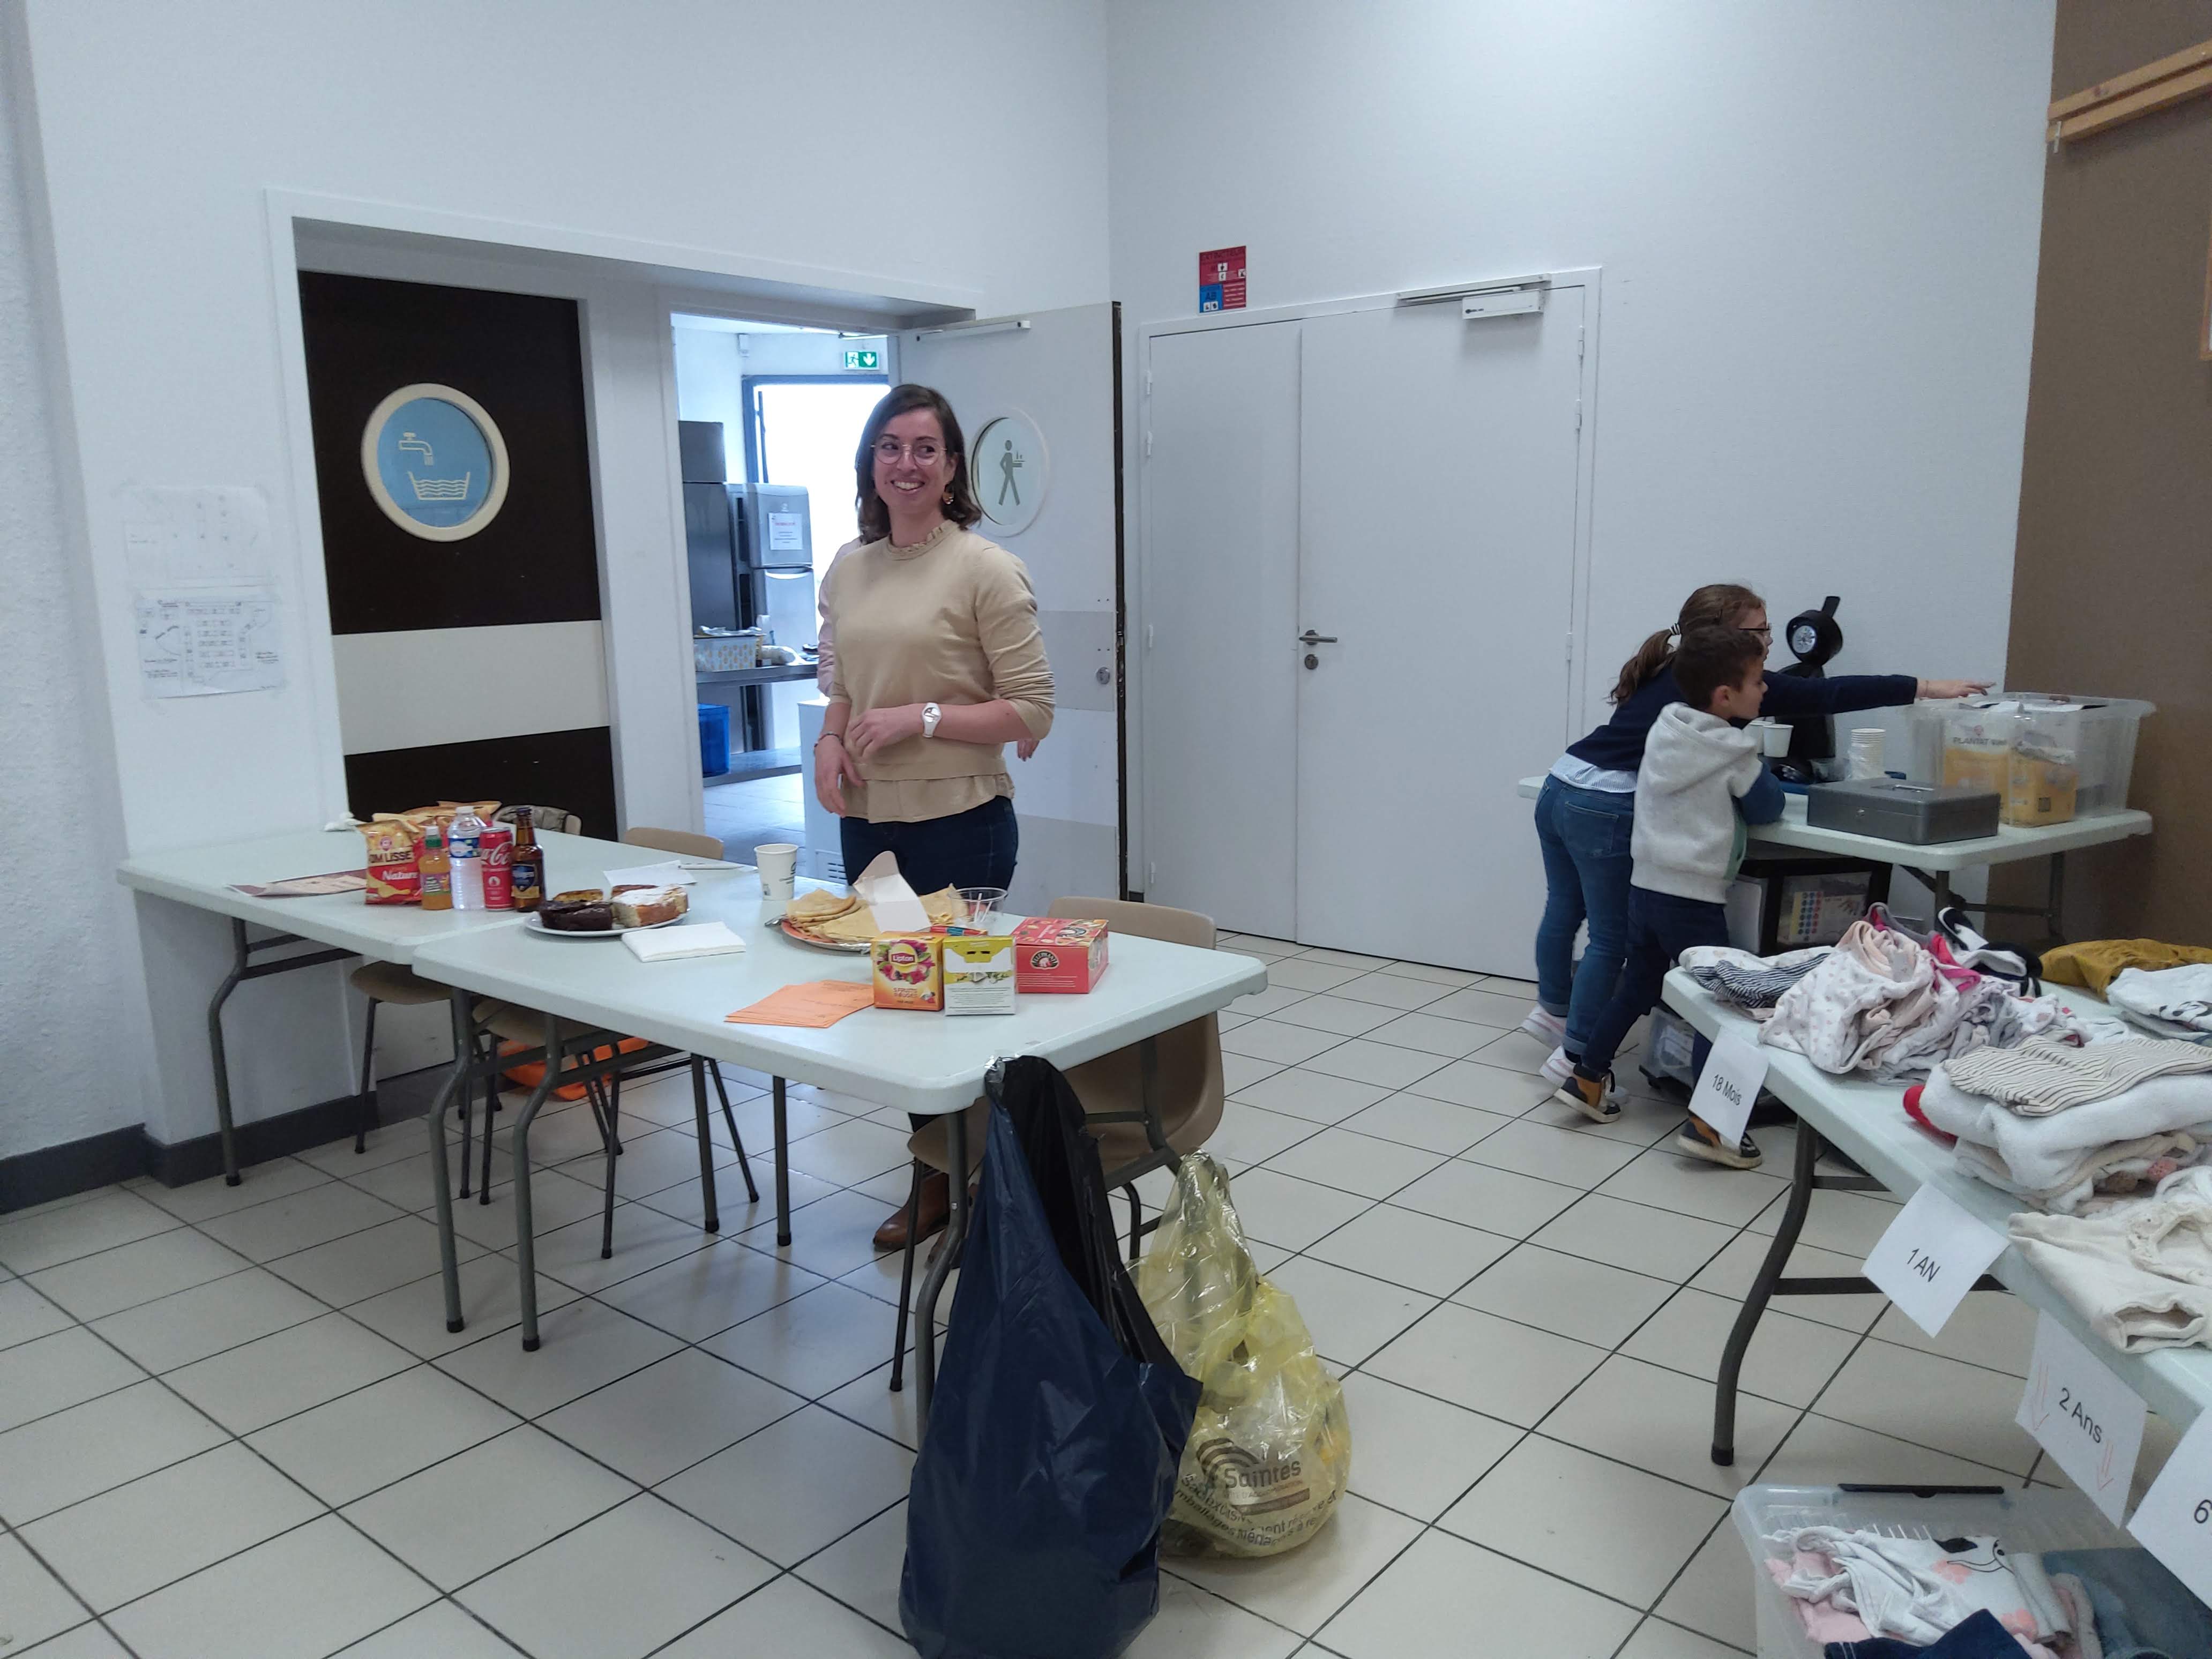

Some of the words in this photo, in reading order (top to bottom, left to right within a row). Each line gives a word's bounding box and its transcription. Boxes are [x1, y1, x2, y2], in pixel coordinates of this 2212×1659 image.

[1712, 1074, 1723, 1092] 18
[1722, 1081, 1742, 1105] Mois
[1906, 1248, 1918, 1265] 1
[1914, 1256, 1941, 1282] AN
[2058, 1388, 2073, 1410] 2
[2072, 1401, 2103, 1444] Ans
[1225, 1460, 1301, 1488] Saintes
[2194, 1499, 2212, 1523] 6
